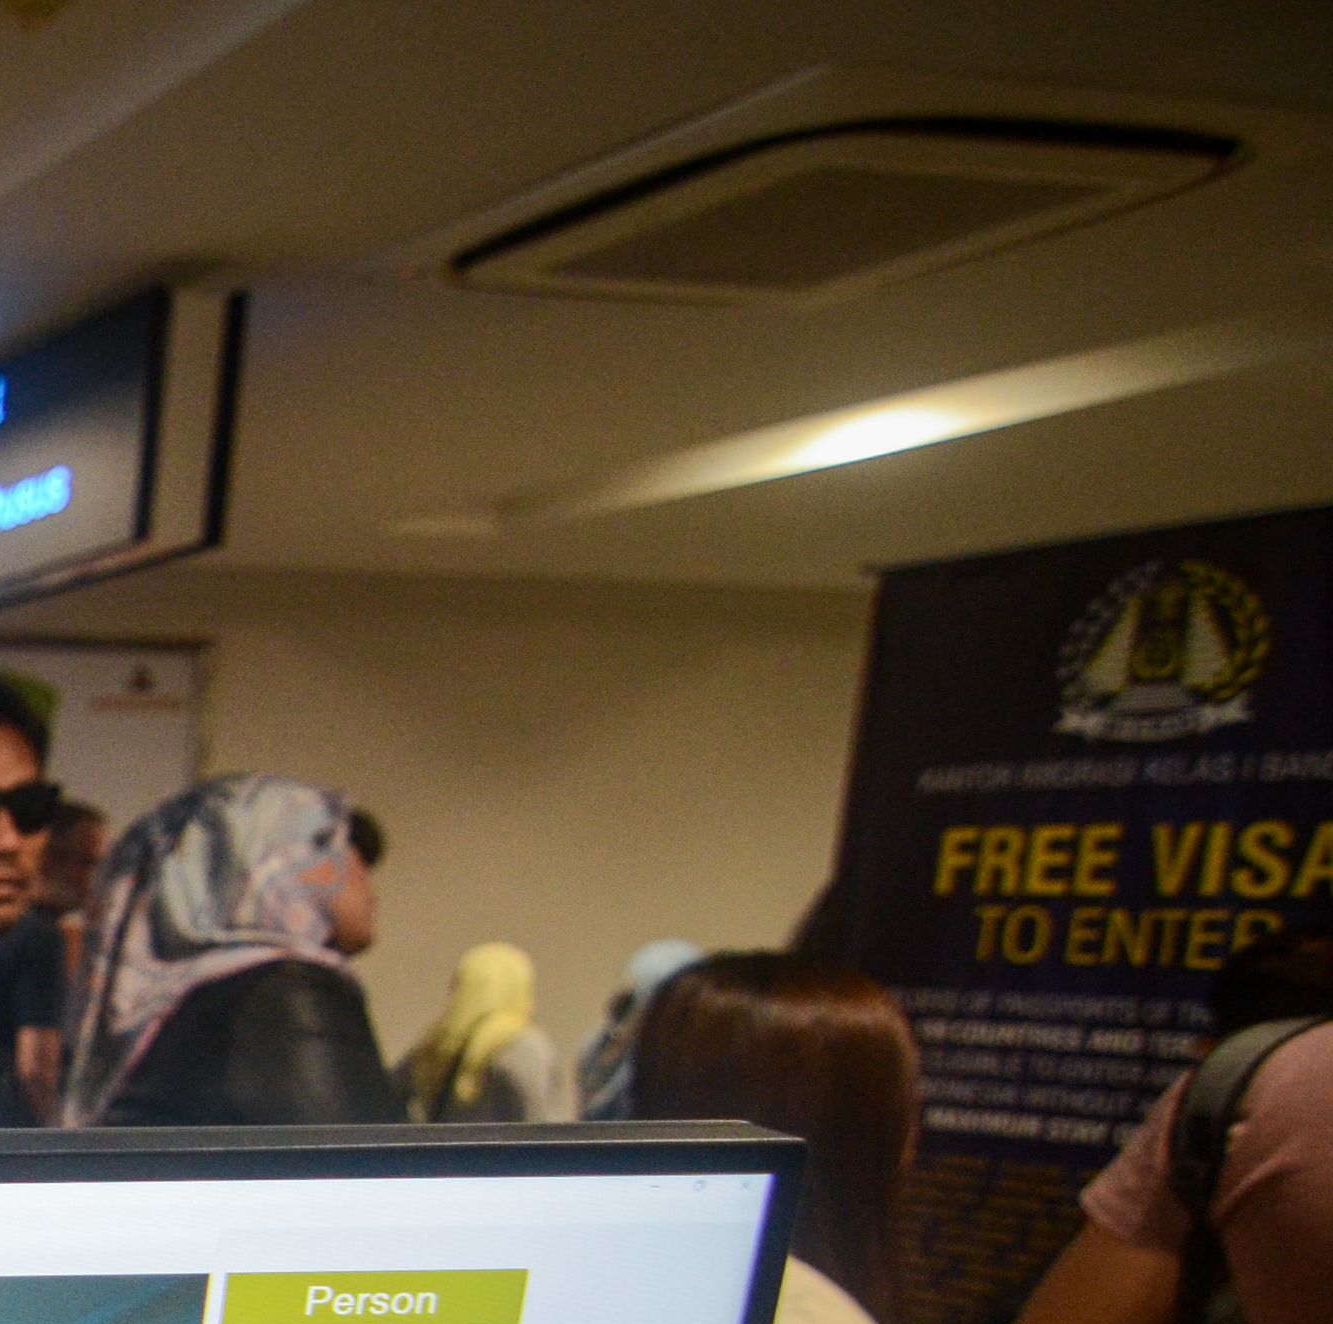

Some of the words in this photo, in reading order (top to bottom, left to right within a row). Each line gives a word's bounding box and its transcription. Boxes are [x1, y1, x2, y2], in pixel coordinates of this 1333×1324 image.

[934, 822, 1124, 897] FREE
[1150, 820, 1333, 899] VISA
[975, 905, 1052, 966] TO
[305, 1285, 439, 1316] Person
